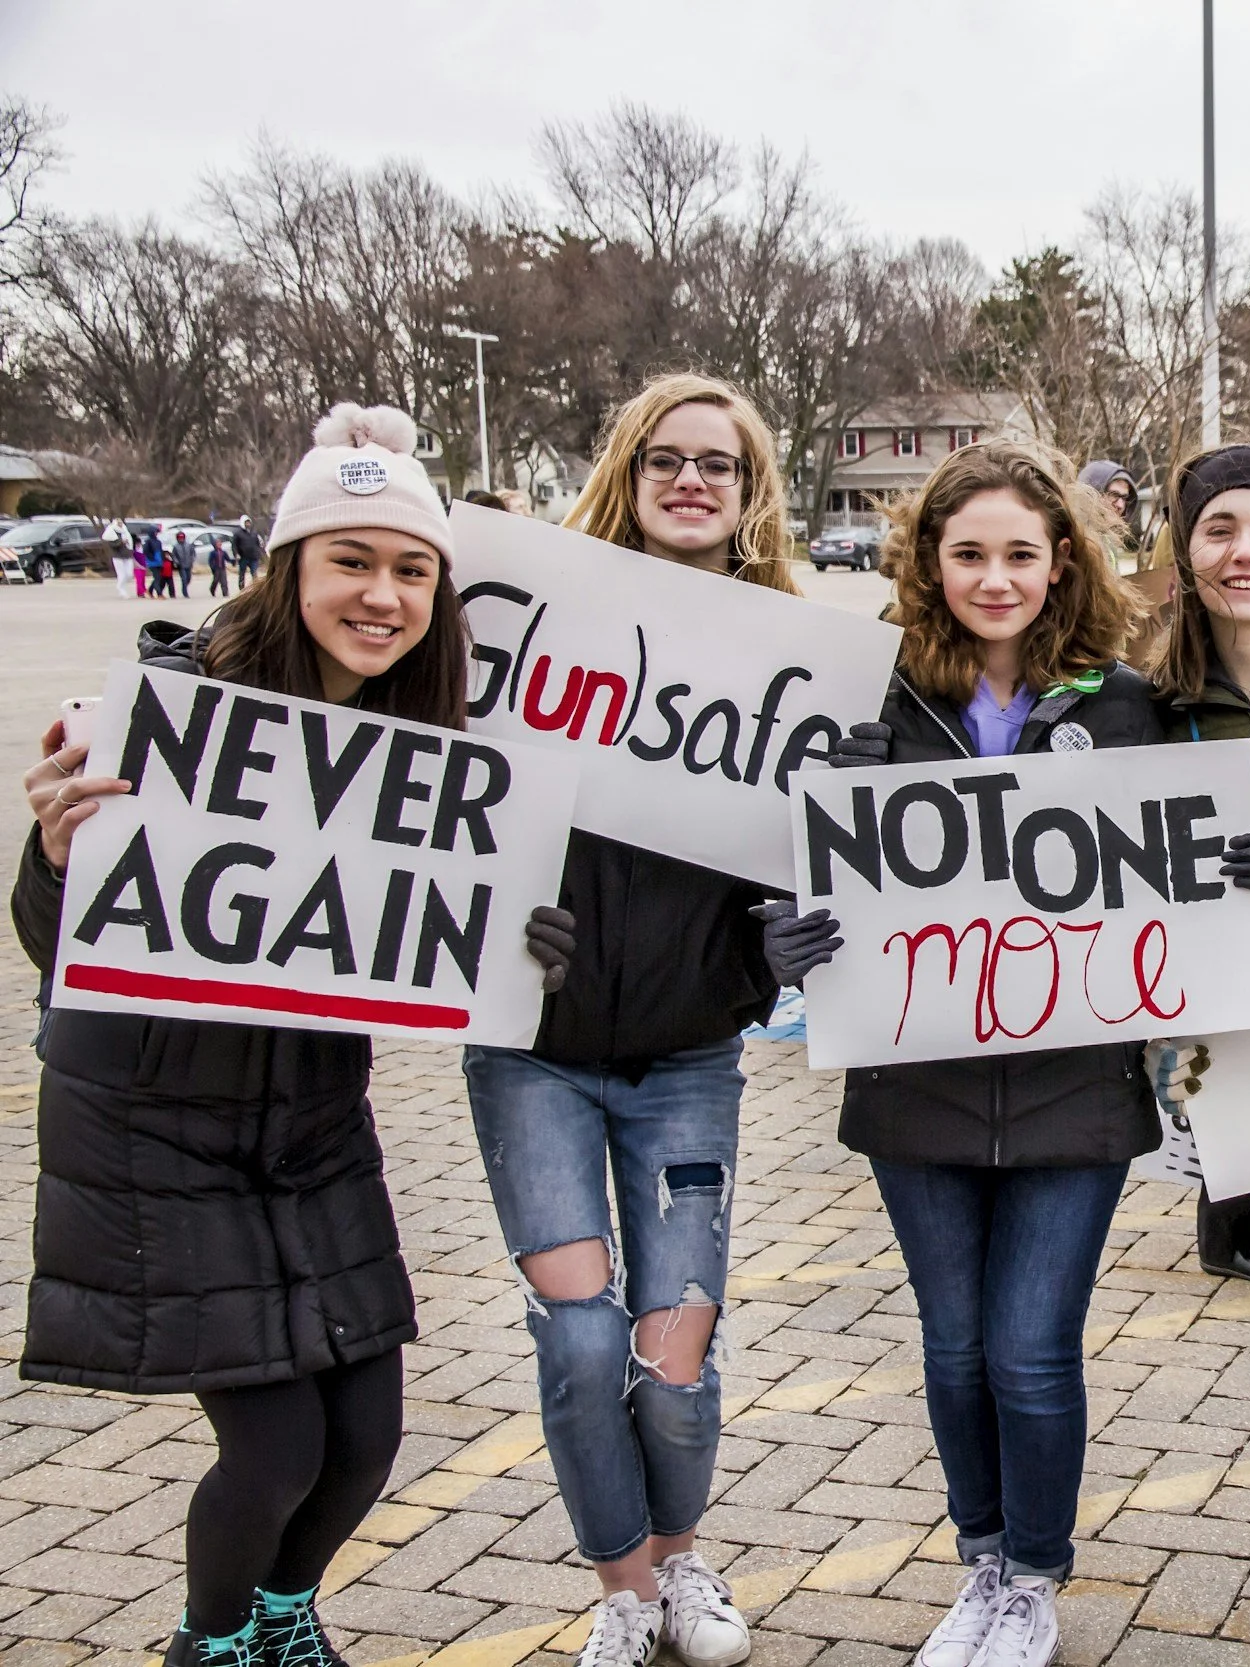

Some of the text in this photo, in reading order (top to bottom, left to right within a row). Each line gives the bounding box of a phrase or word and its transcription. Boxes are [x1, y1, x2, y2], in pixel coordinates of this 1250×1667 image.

[339, 461, 379, 470] MARCH
[341, 469, 386, 478] FOR OUR
[342, 477, 372, 486] LIVES
[119, 674, 511, 855] NEVER
[73, 825, 491, 994] AGAIN
[883, 916, 1186, 1045] more
